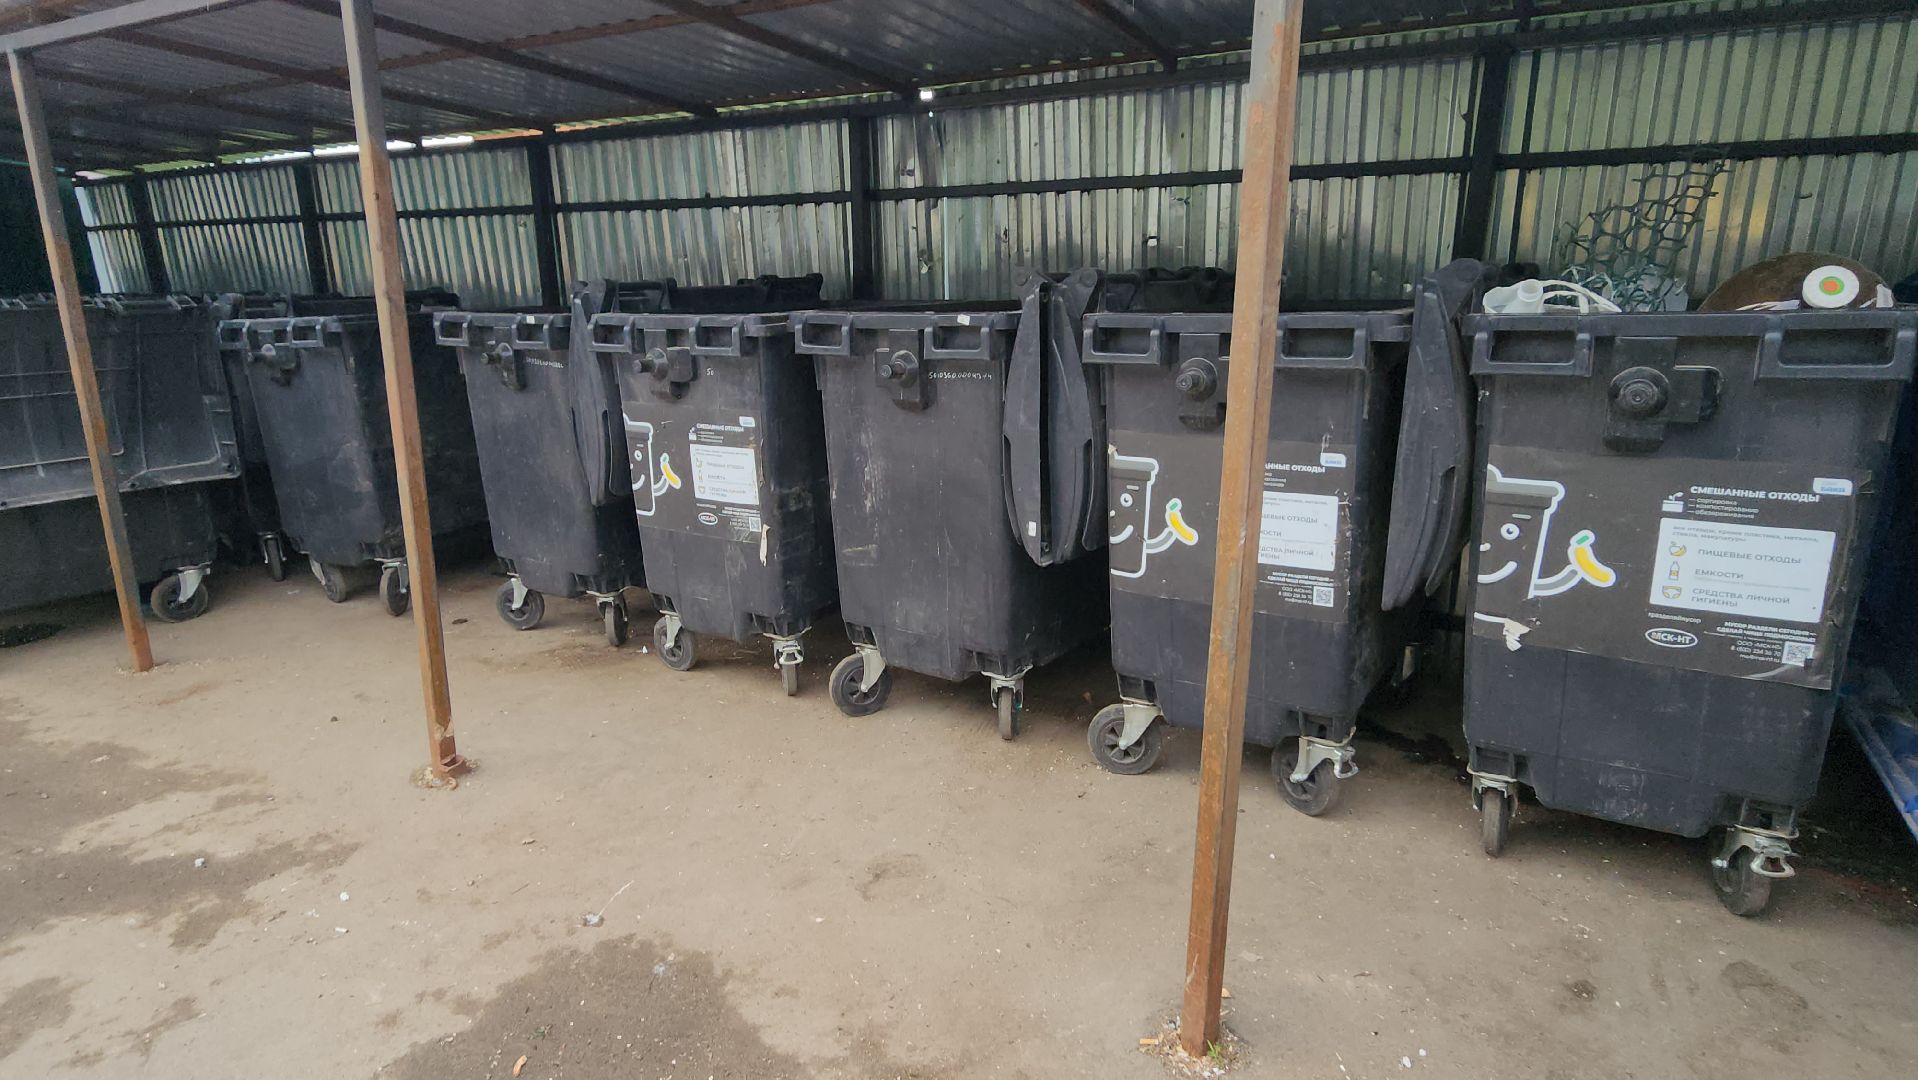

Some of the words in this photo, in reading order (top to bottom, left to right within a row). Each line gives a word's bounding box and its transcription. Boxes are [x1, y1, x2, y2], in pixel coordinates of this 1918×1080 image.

[1291, 464, 1325, 473] ОТХОДЫ
[1690, 486, 1766, 499] СМЕШАННЫЕ
[1768, 491, 1820, 502] ОТХОДЫ
[1287, 515, 1318, 523] ОТХОДЫ
[1698, 549, 1752, 560] ПИЩЕВЫЕ
[1754, 554, 1801, 564] ОТХОДЫ
[1695, 568, 1744, 579] ЕМКОСТИ
[1692, 588, 1743, 600] СРЕДСТВА
[1746, 592, 1790, 604] ЛИЧНОЙ
[1691, 597, 1738, 607] ГИГИЕНЫ
